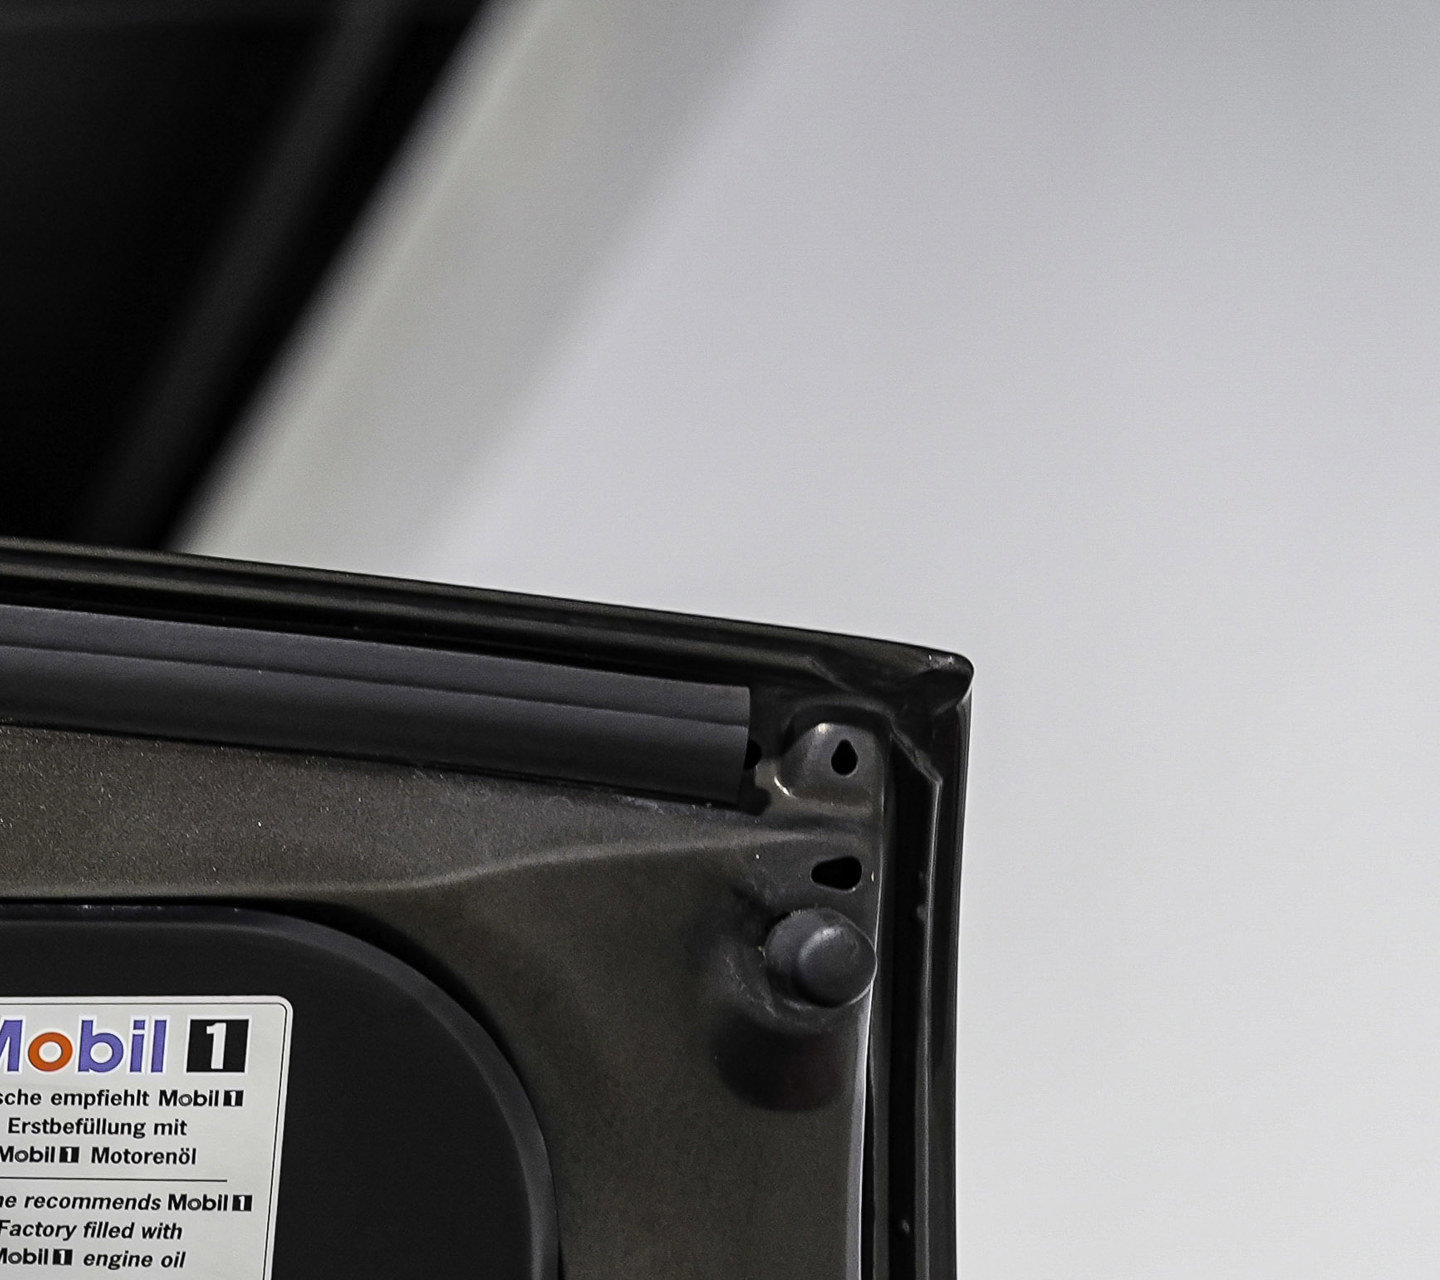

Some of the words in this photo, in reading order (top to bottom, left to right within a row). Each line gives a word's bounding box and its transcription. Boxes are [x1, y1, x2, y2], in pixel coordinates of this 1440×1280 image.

[51, 1089, 149, 1109] empfiehlt
[8, 1118, 146, 1139] Erstbefüllung
[154, 1119, 187, 1135] mit
[92, 1147, 196, 1164] Motorenöl
[25, 1194, 161, 1210] recommends
[84, 1222, 134, 1238] filled
[142, 1223, 182, 1239] with
[84, 1251, 152, 1270] engine
[161, 1252, 185, 1267] oil
